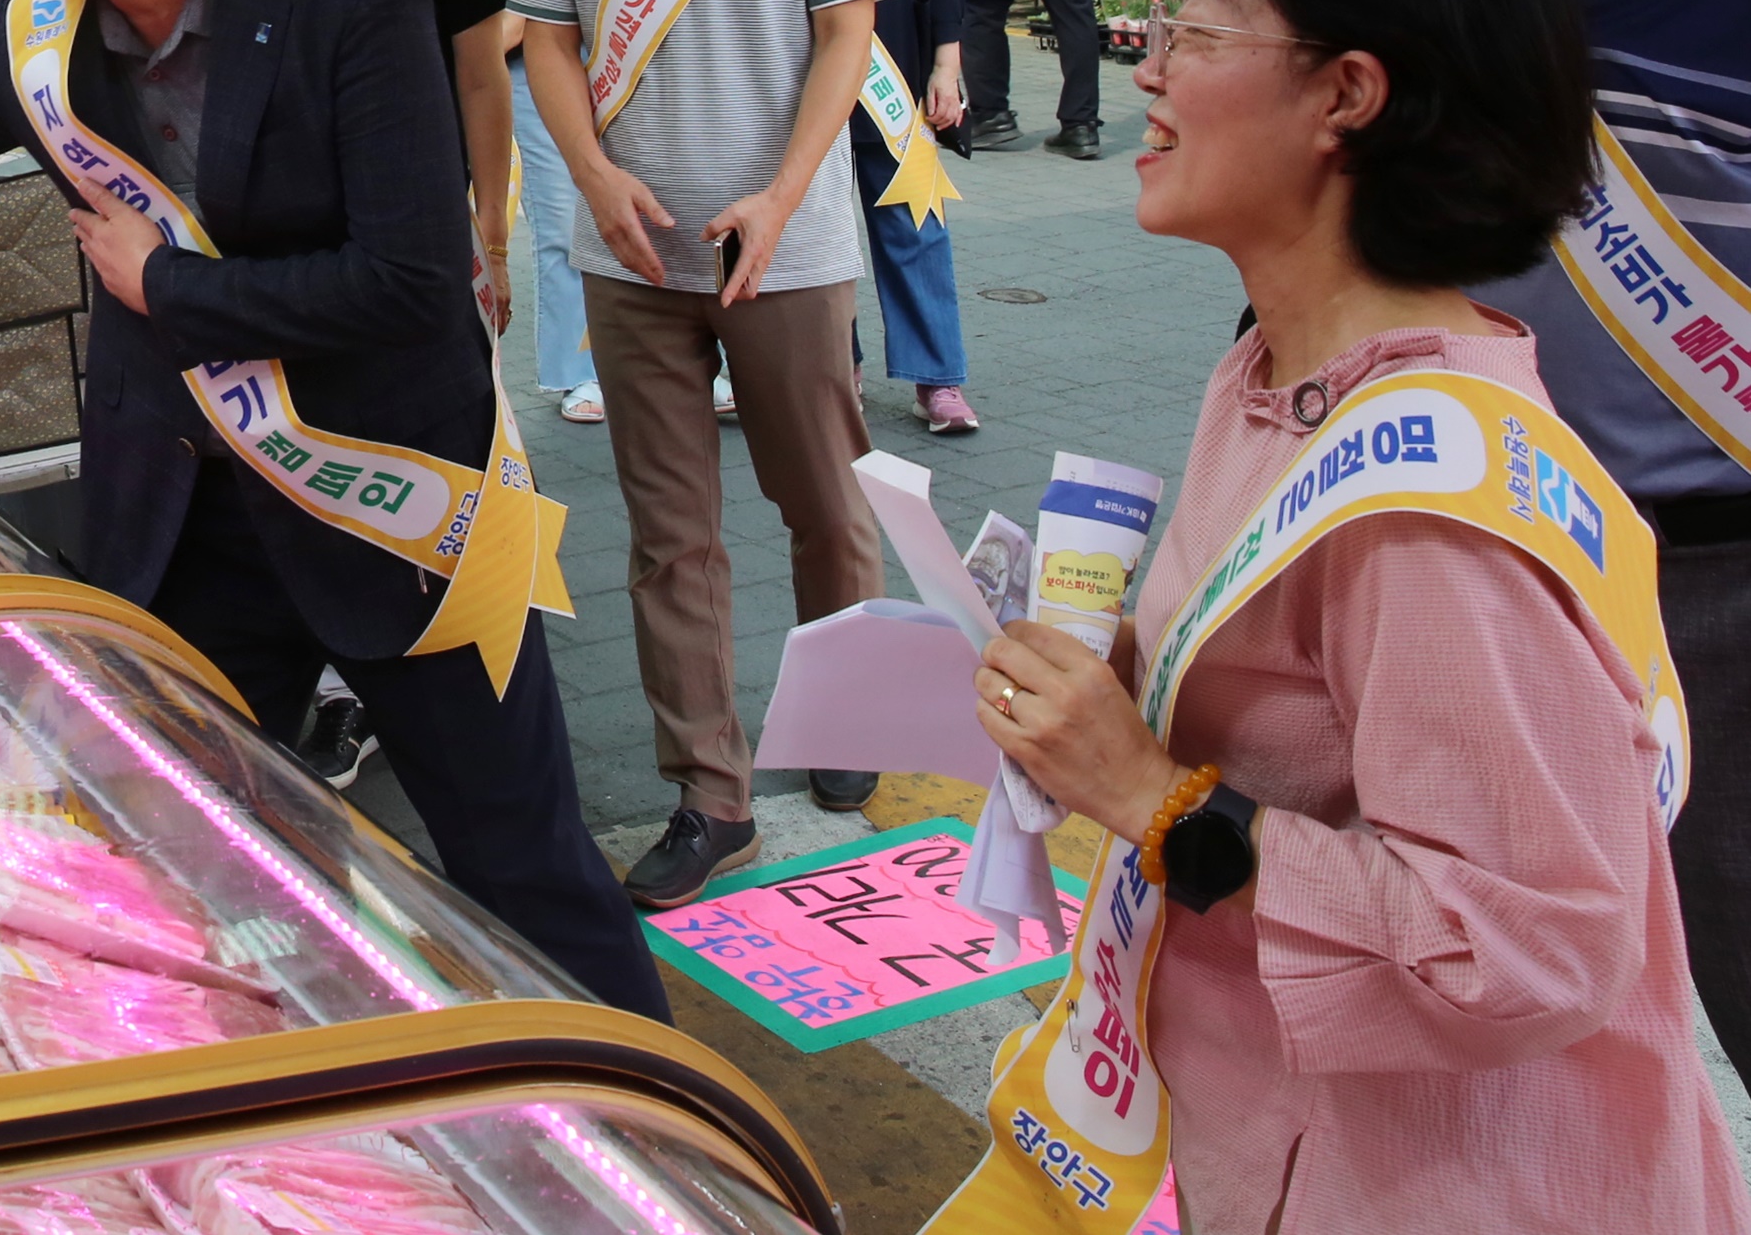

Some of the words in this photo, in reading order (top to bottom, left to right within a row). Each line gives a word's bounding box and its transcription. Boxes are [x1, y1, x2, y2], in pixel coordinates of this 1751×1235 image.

[255, 429, 416, 515] 캠페인
[1500, 415, 1535, 525] 수원특례시
[1046, 577, 1120, 598] 보이스피싱입니다!
[1013, 1108, 1117, 1213] 장안구
